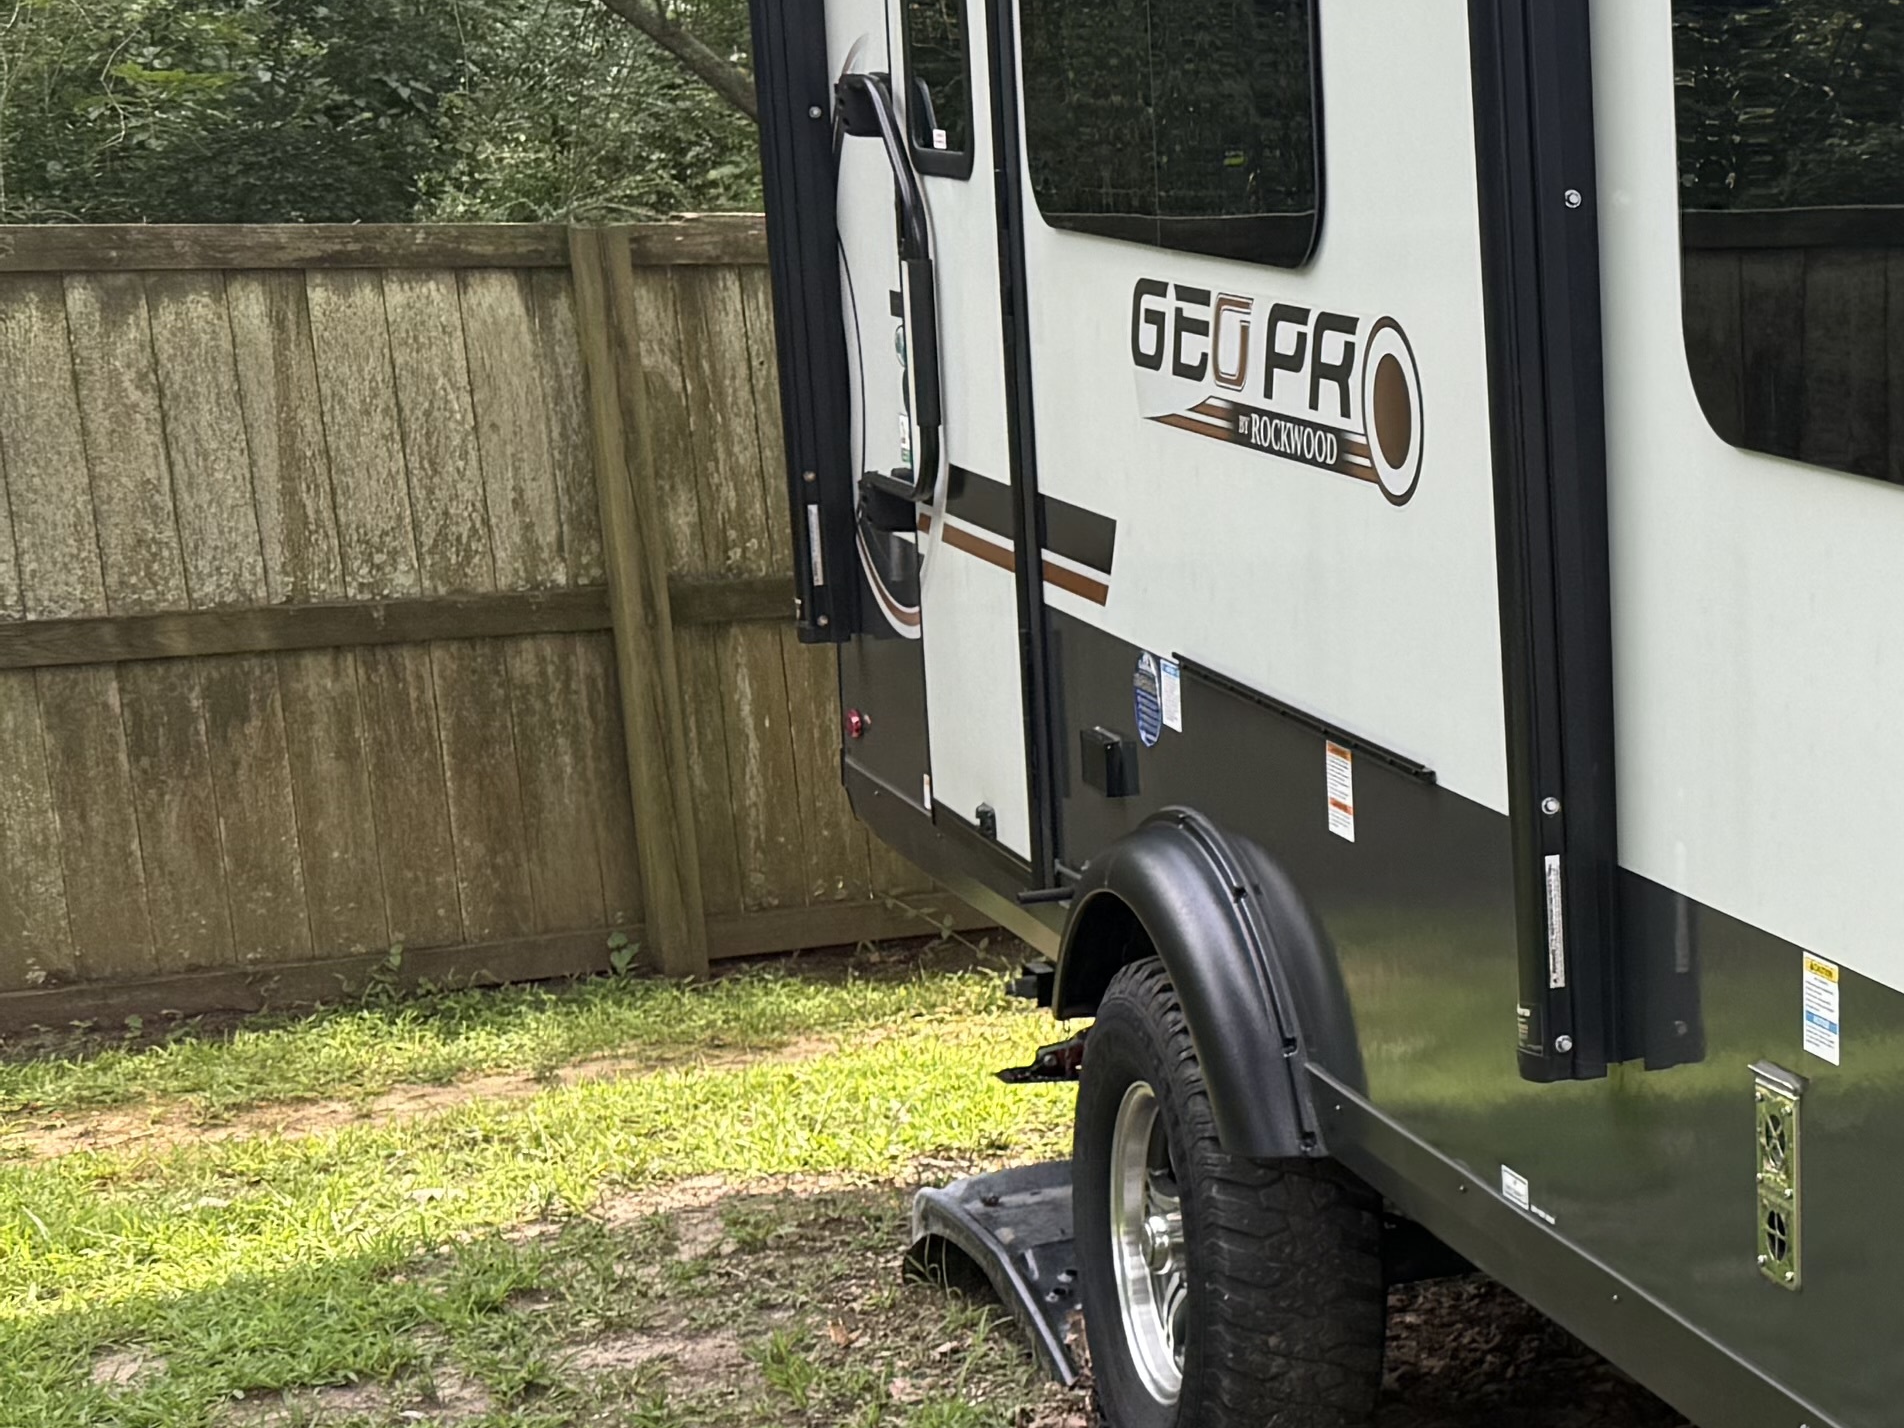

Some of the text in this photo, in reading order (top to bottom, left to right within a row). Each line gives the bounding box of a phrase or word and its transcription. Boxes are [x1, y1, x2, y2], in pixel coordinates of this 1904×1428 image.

[1130, 277, 1255, 392] GEO
[1238, 413, 1339, 466] BY ROCKWOOD
